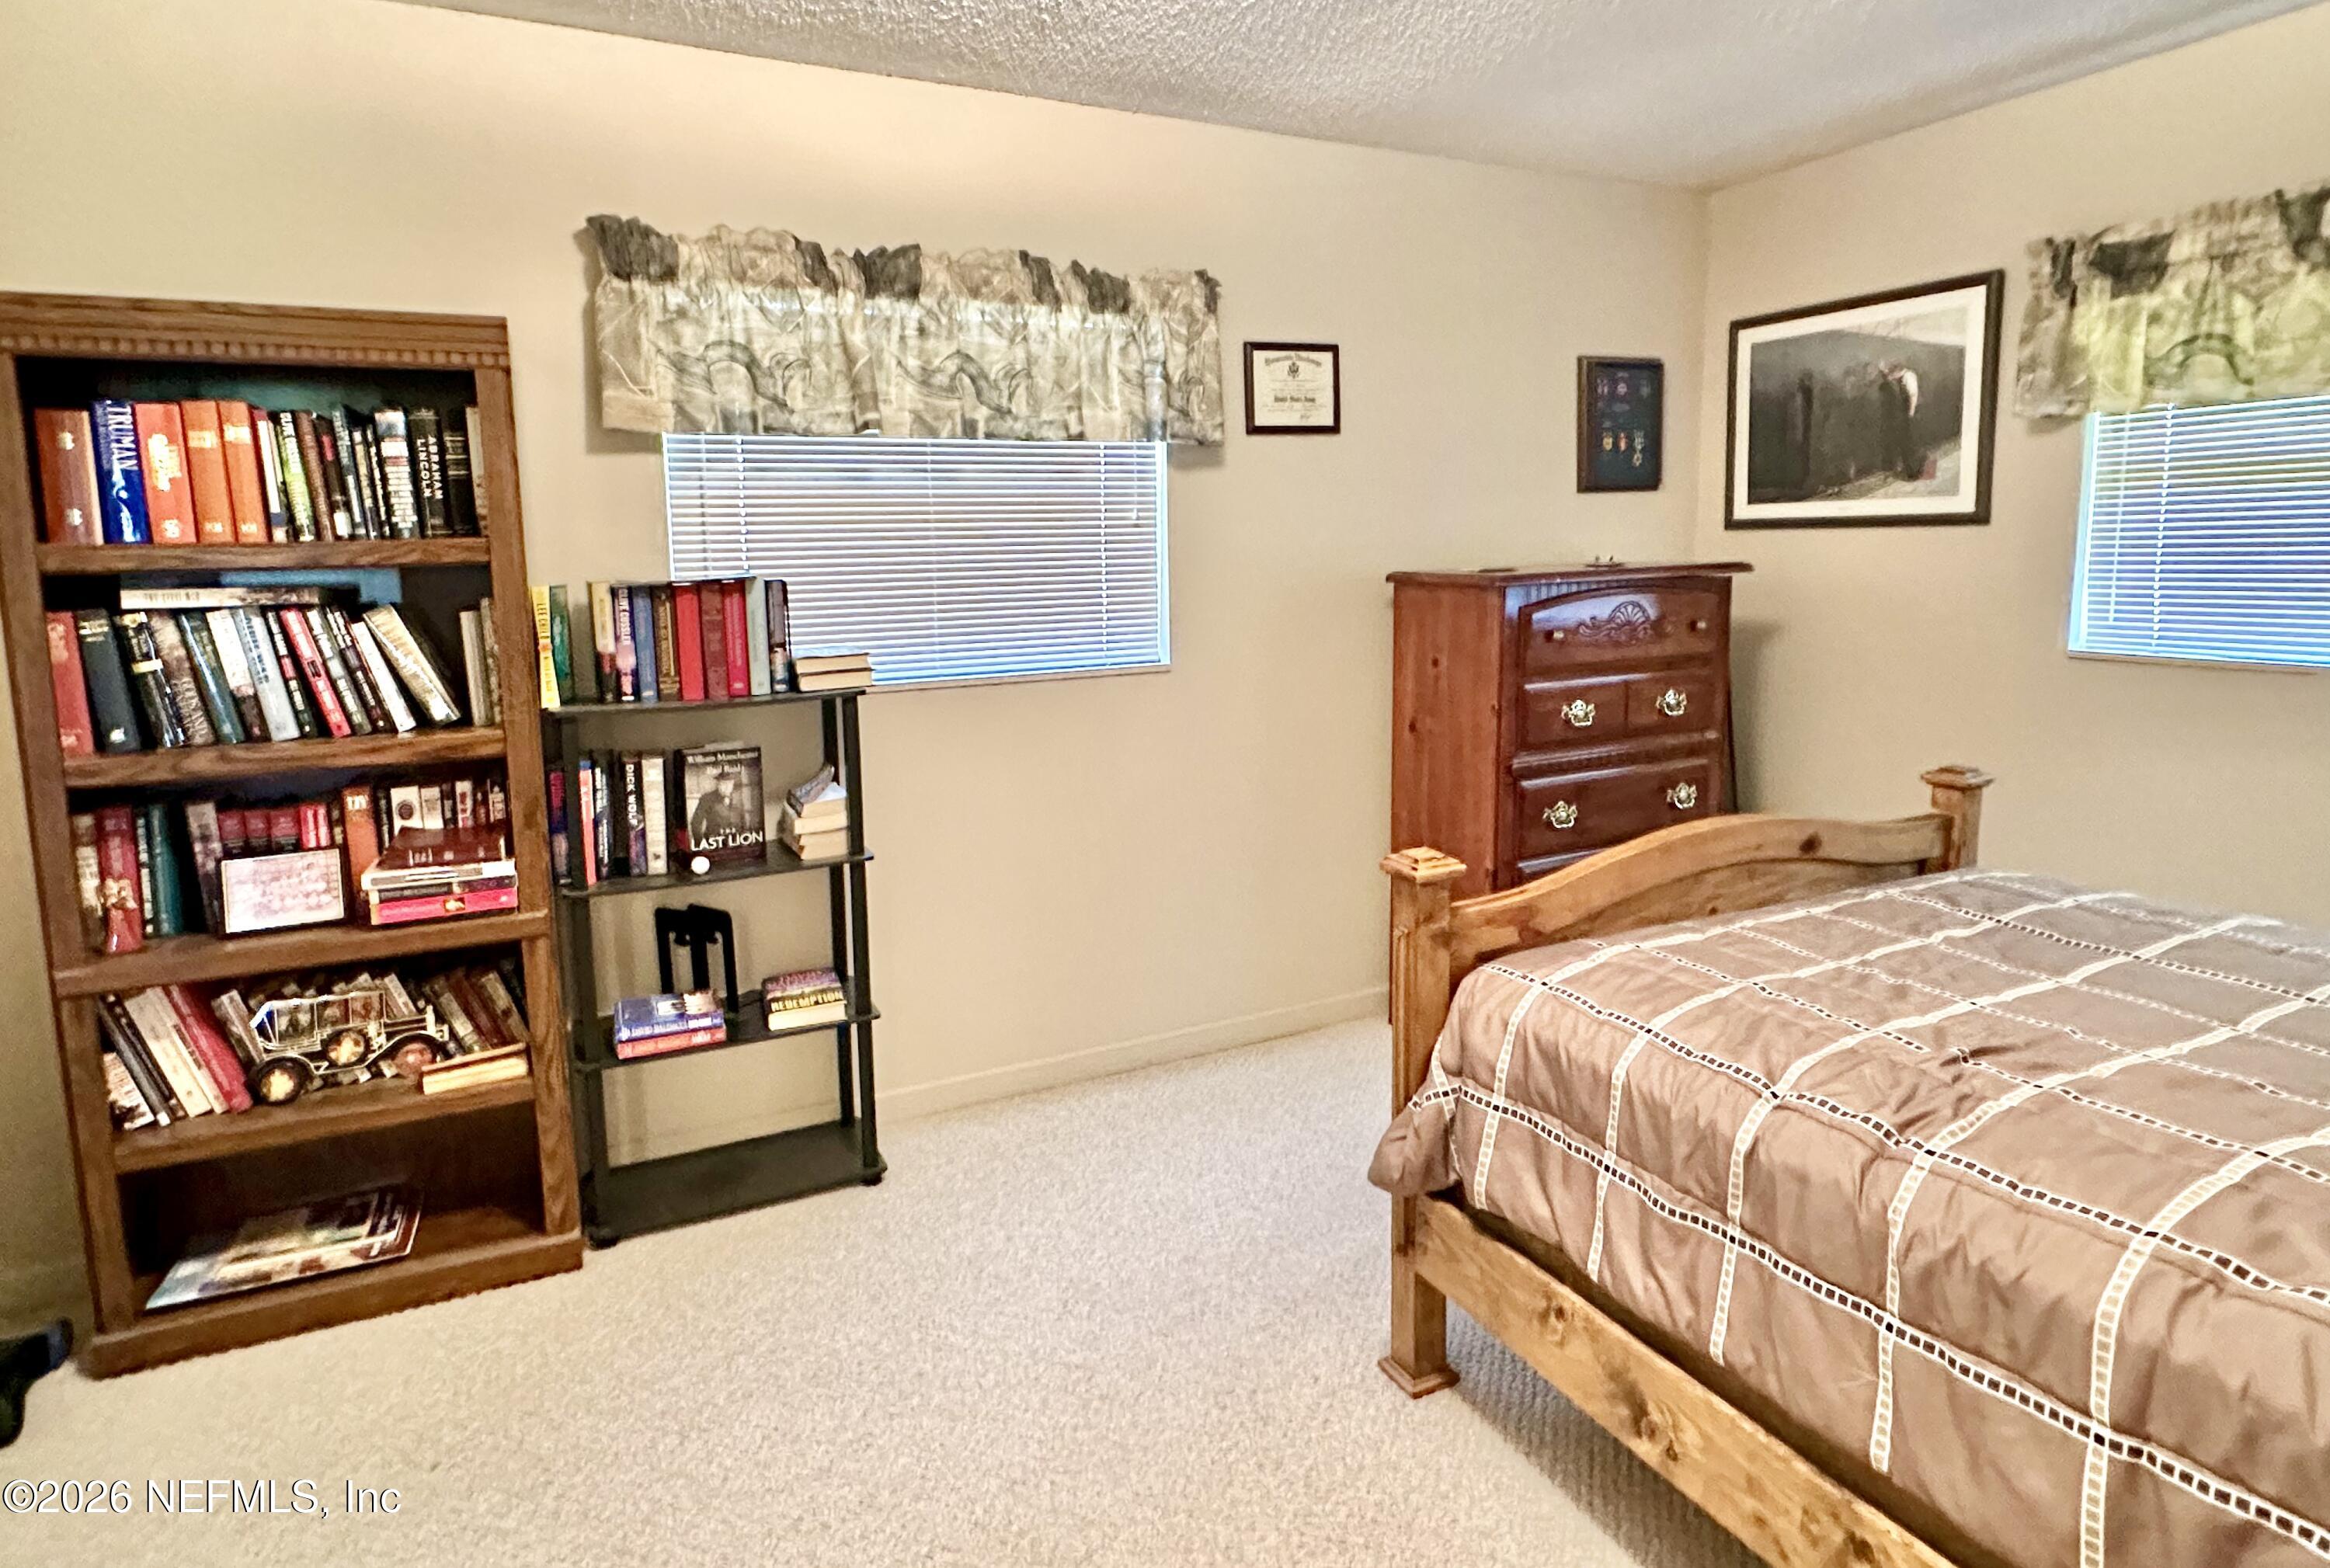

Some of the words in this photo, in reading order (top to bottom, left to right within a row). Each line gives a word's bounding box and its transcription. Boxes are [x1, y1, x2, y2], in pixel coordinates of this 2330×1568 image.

[108, 405, 138, 471] TRUMAN
[417, 439, 433, 497] LINCOLN
[428, 434, 443, 499] ABRAHAM
[537, 603, 547, 616] LEE
[620, 611, 631, 645] CUSSLER
[624, 763, 636, 791] DICK
[626, 794, 638, 826] WOLF
[691, 836, 725, 851] LAST
[729, 831, 763, 847] LION
[771, 990, 844, 1013] REDEMPTION
